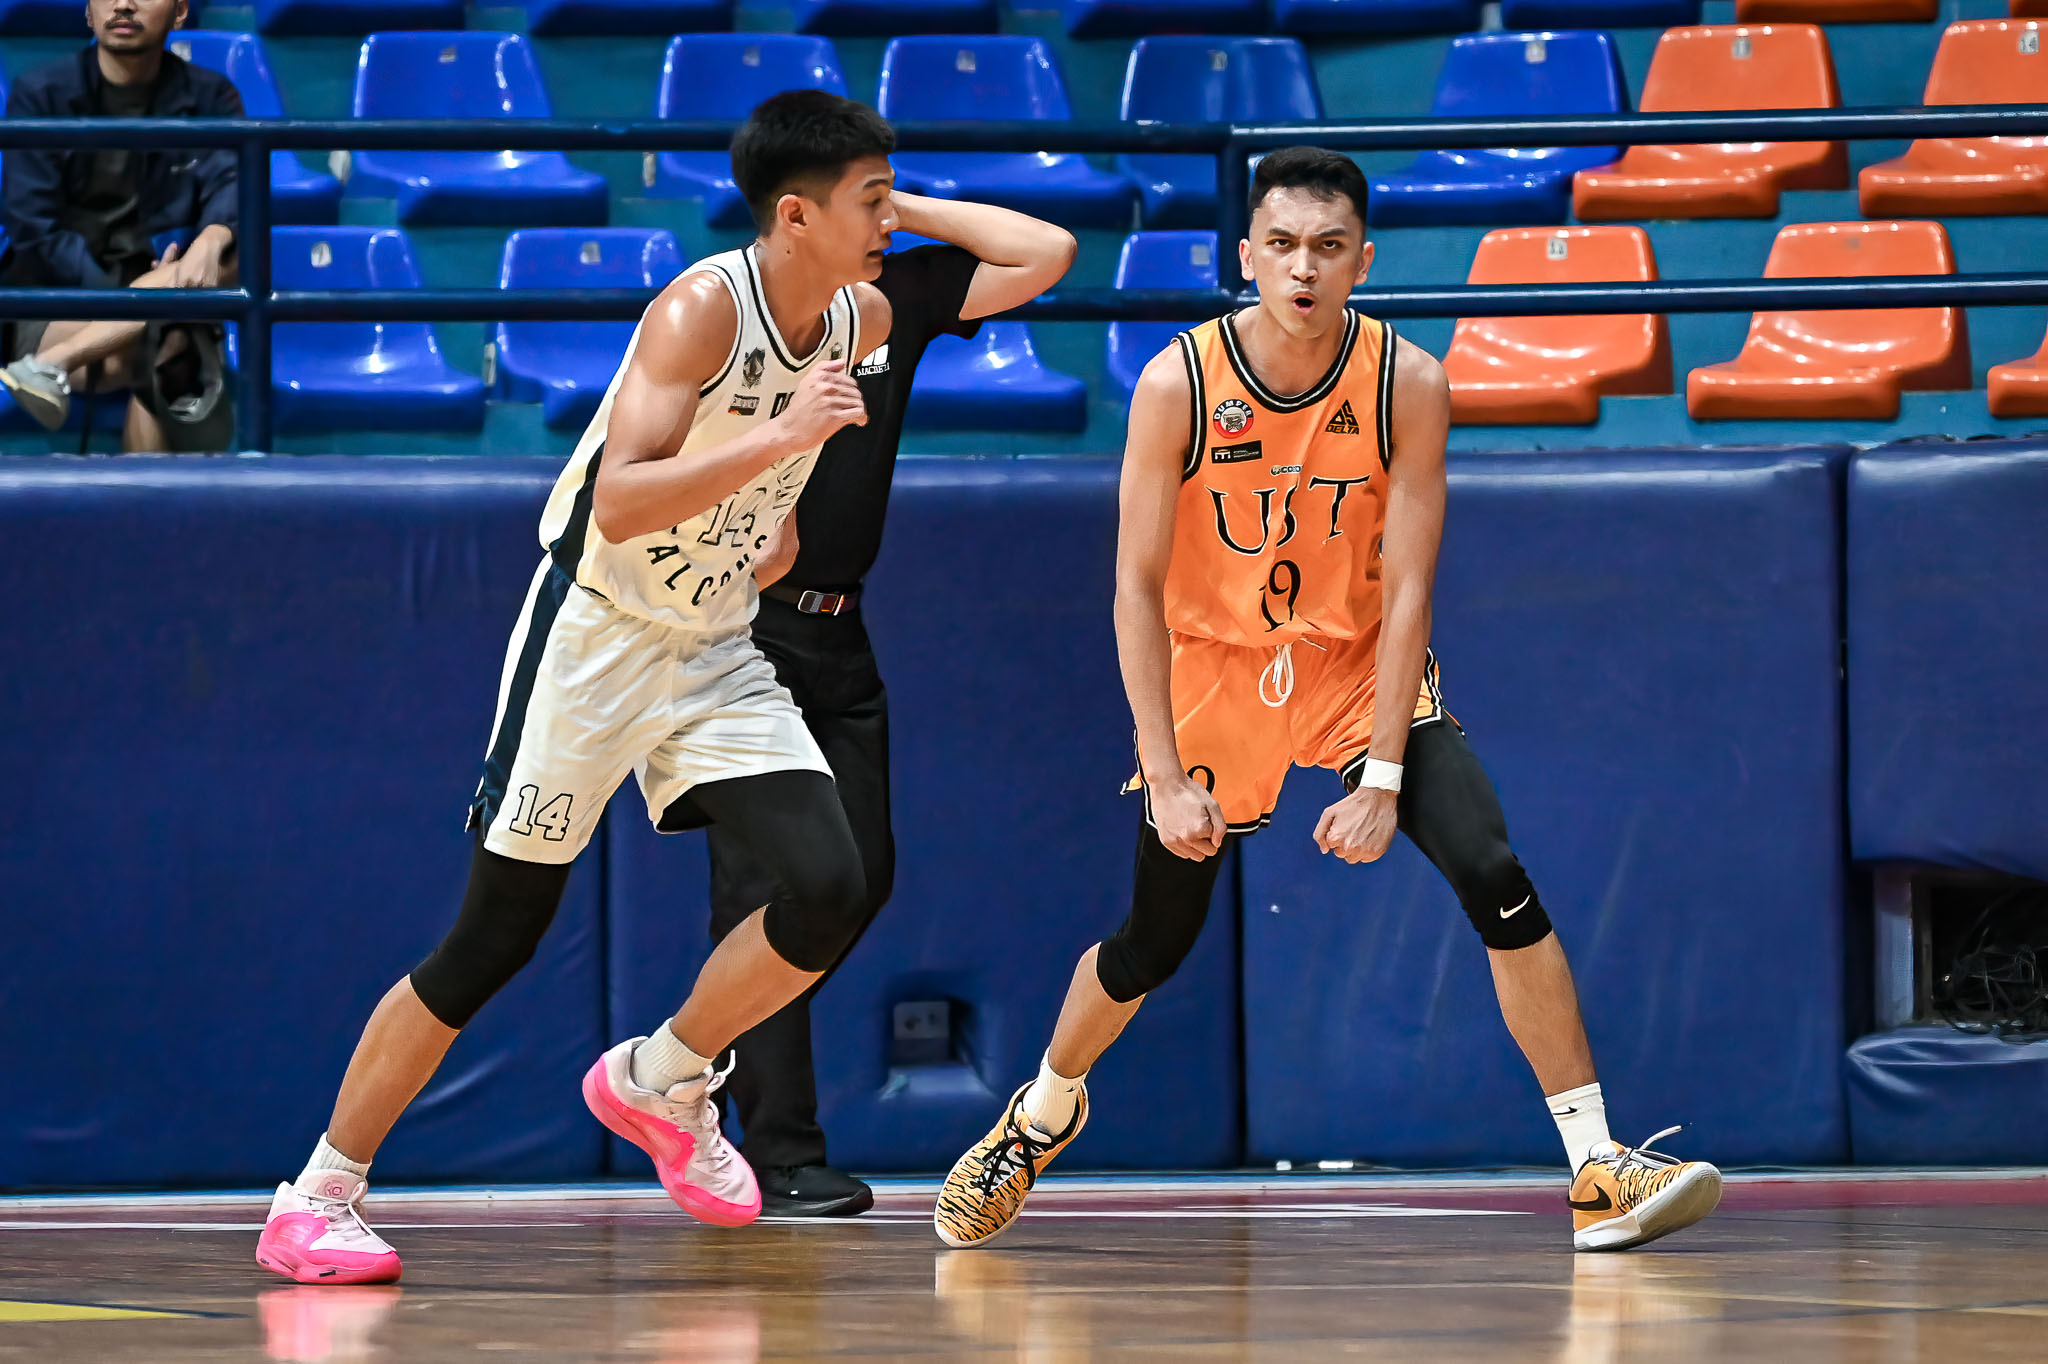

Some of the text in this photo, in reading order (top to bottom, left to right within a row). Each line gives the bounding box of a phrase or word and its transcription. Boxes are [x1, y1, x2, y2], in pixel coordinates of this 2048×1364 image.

[1213, 400, 1252, 420] DUMPER
[1325, 424, 1360, 435] DELTA
[509, 783, 574, 842] 14
